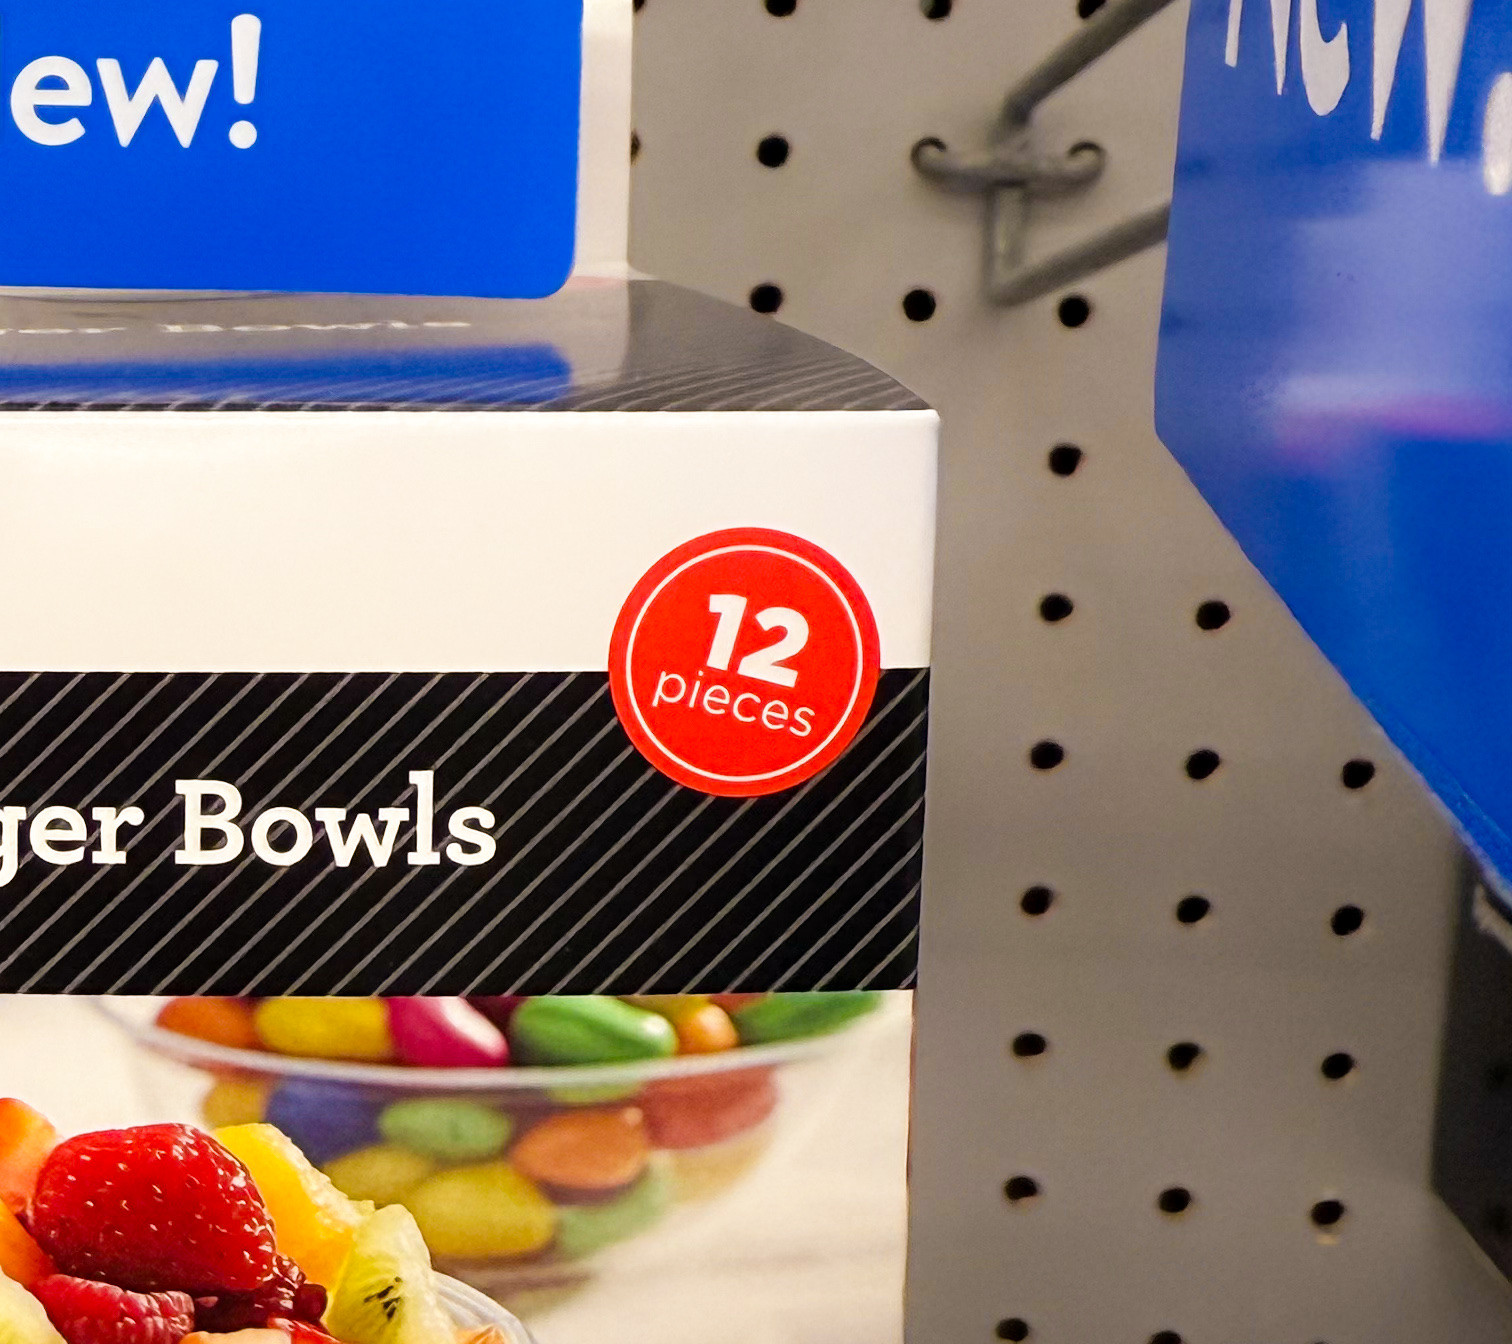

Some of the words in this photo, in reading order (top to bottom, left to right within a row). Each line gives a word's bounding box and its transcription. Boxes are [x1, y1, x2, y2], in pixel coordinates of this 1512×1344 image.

[706, 594, 809, 688] 12
[652, 669, 816, 737] pieces
[175, 768, 496, 869] Bowls
